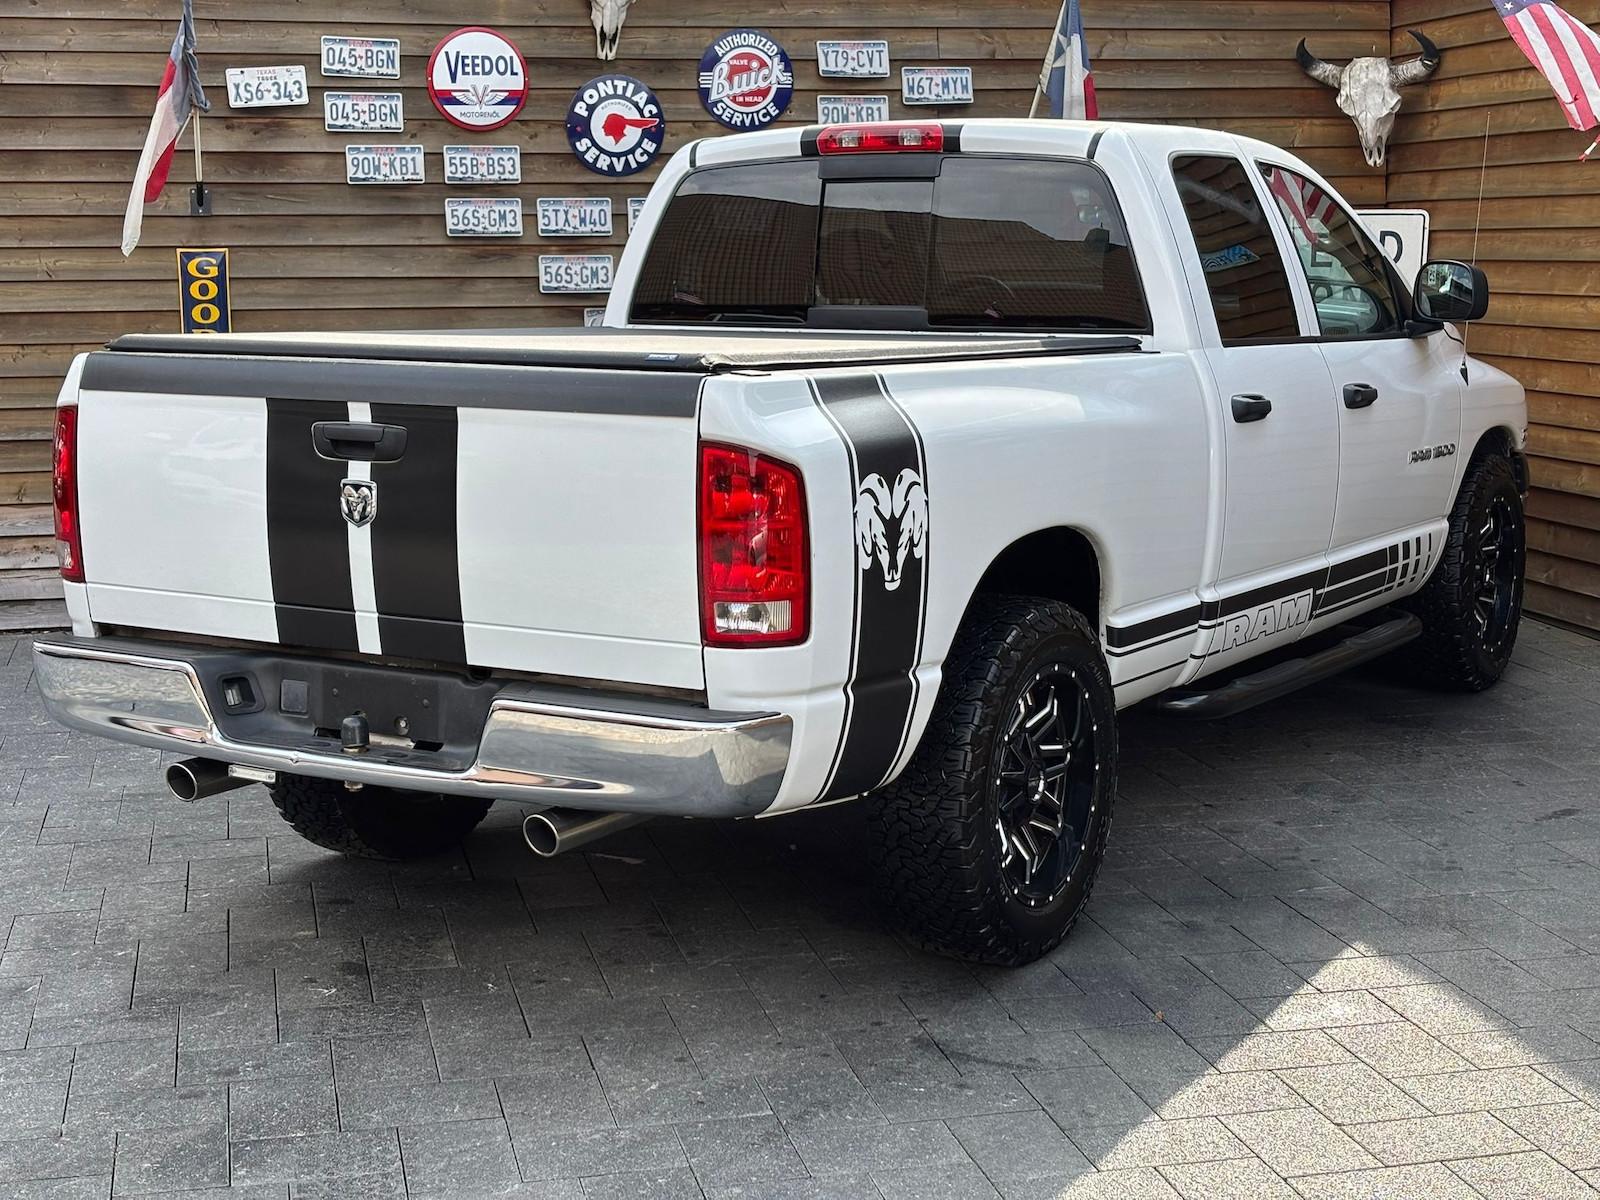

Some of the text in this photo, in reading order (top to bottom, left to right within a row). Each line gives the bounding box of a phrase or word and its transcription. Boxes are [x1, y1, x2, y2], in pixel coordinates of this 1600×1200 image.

[713, 33, 778, 57] AUTHORIZED
[365, 49, 395, 69] BGN
[444, 51, 518, 83] VEEDOL
[822, 50, 884, 68] Y79 CVT
[708, 55, 787, 102] Buick
[233, 80, 303, 102] XS6 343
[574, 80, 658, 117] PONTIAC
[368, 103, 398, 122] BGN
[712, 102, 780, 126] SERVICE
[389, 156, 420, 176] KB1
[449, 156, 516, 176] 55B BS3
[575, 138, 657, 172] SERVICE
[488, 209, 517, 227] GM3
[542, 209, 571, 227] 5TX
[580, 266, 609, 284] GM3
[187, 257, 221, 333] GOO
[1222, 592, 1311, 652] RAM
